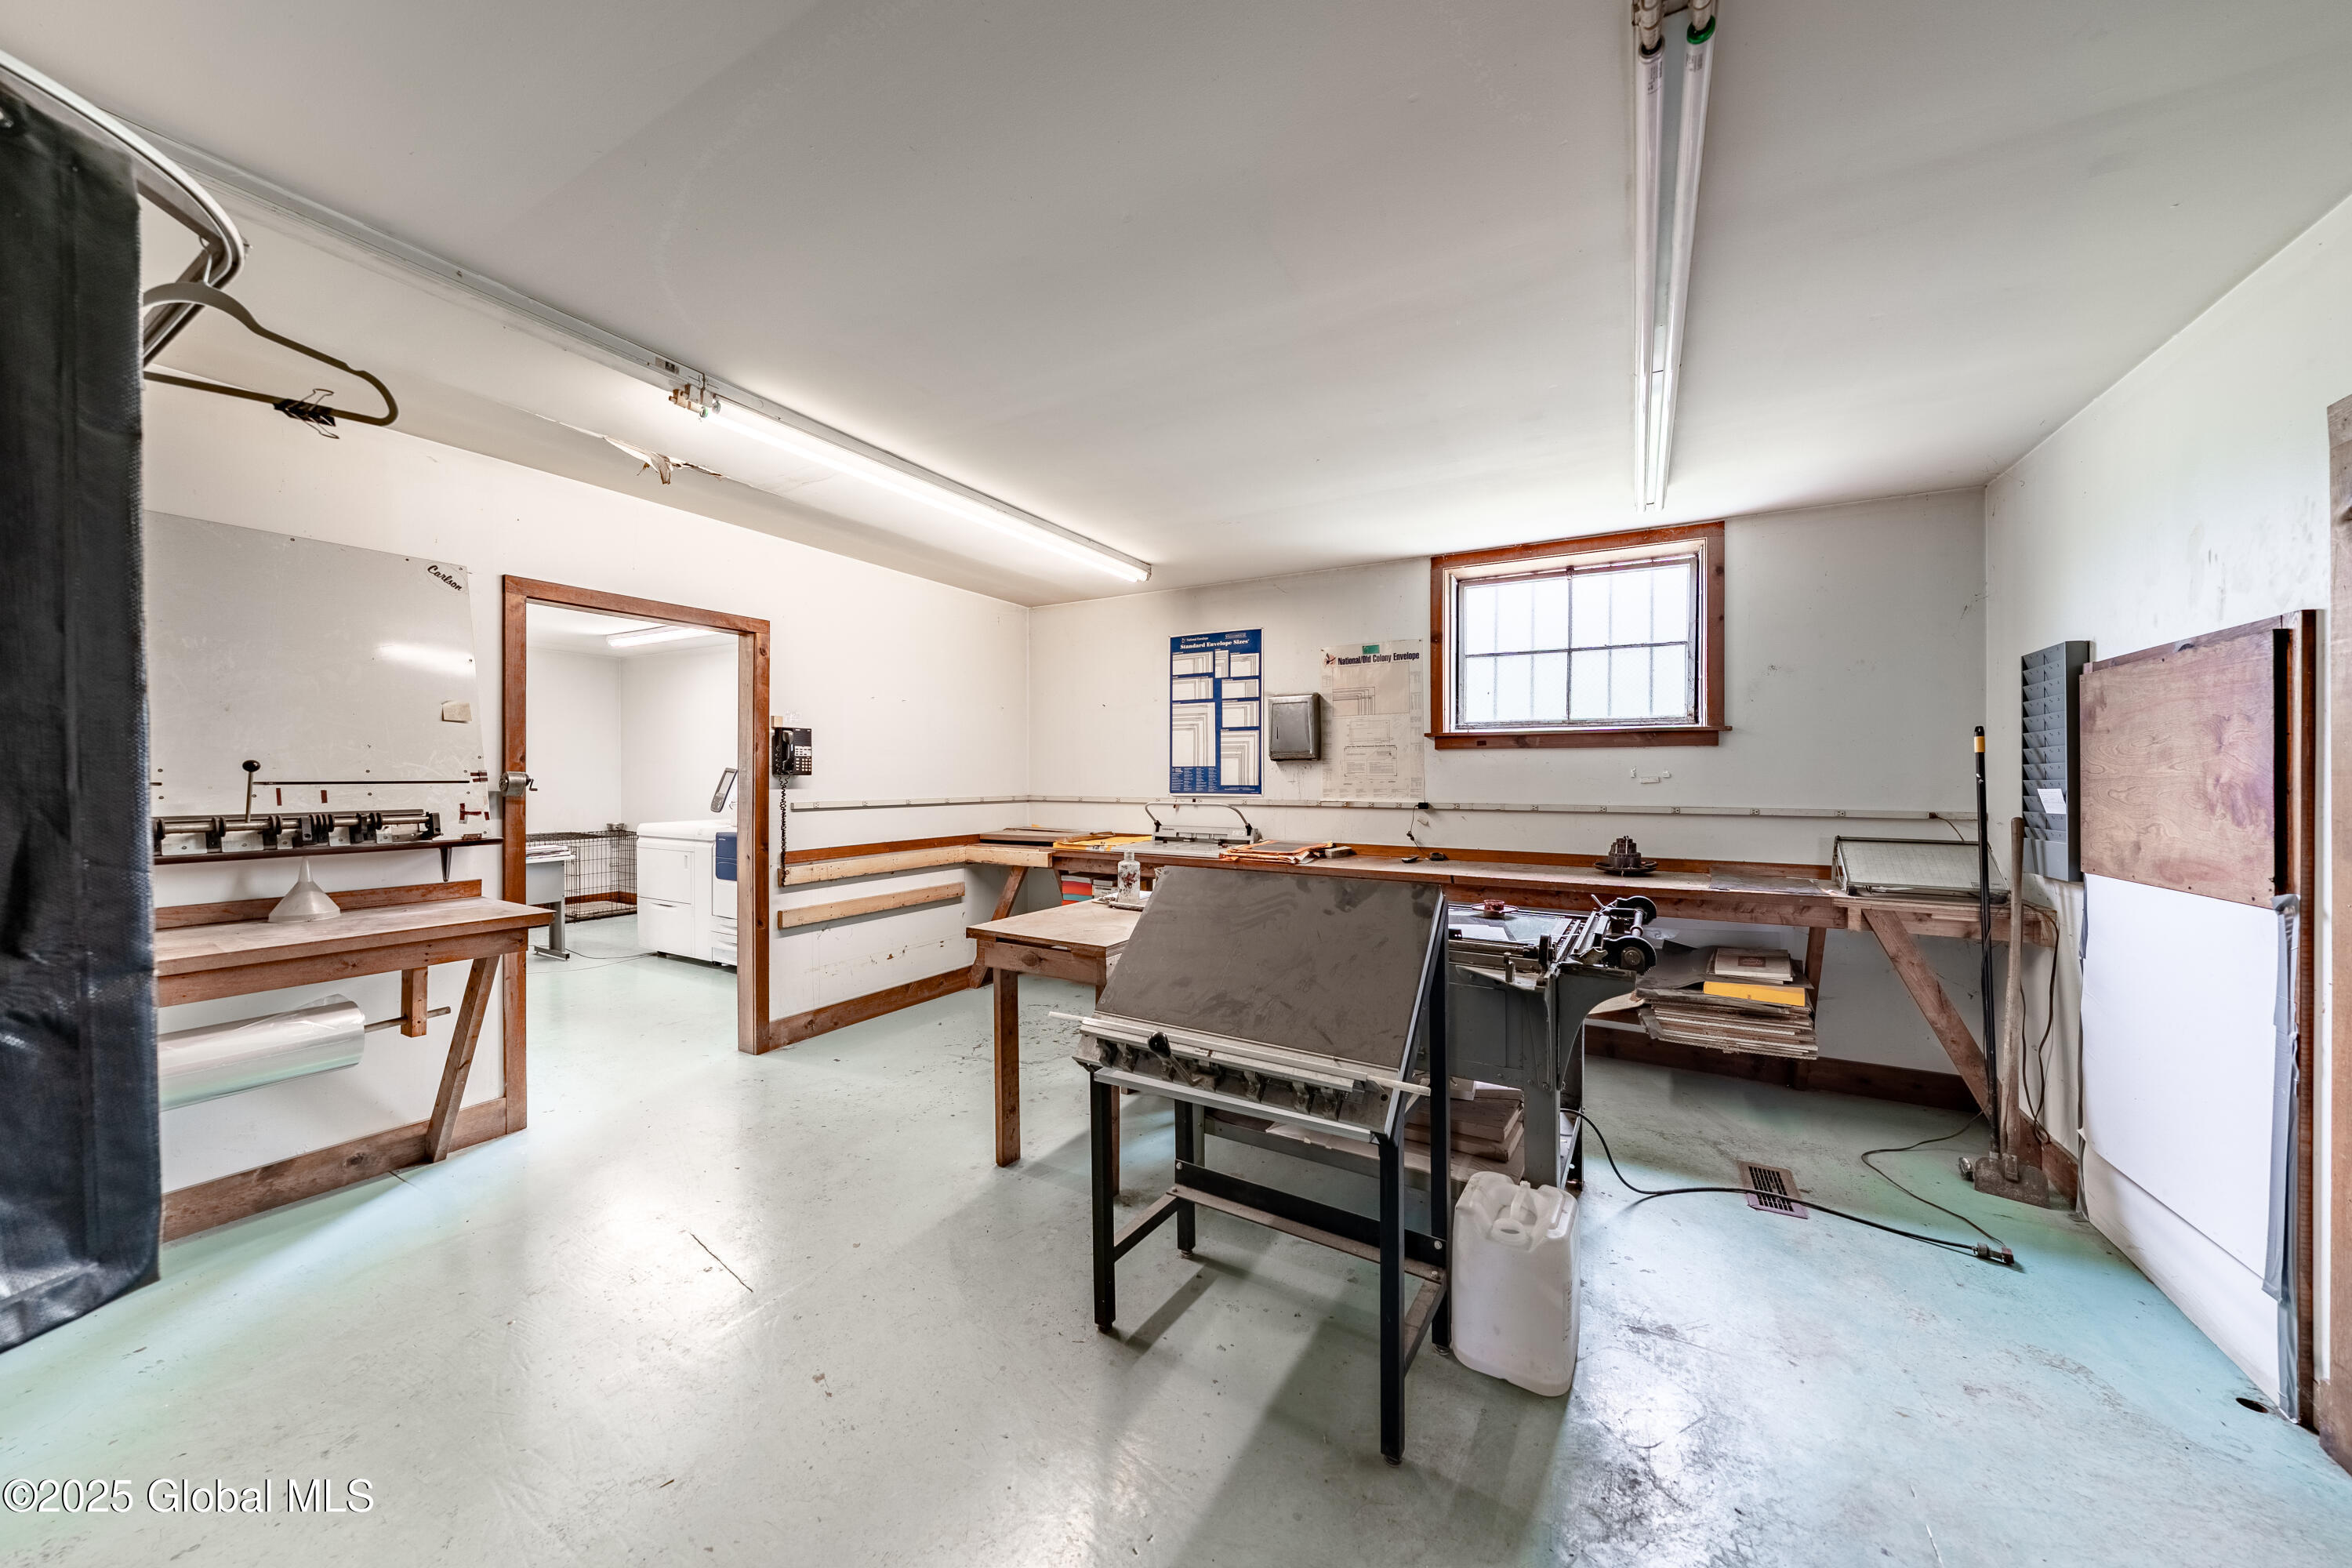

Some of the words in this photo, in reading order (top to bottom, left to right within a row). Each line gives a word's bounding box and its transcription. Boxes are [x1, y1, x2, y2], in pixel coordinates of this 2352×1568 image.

[427, 564, 463, 591] Carlson
[1338, 655, 1371, 666] National/Old
[1373, 654, 1392, 663] Colony
[1393, 652, 1420, 661] Envelope
